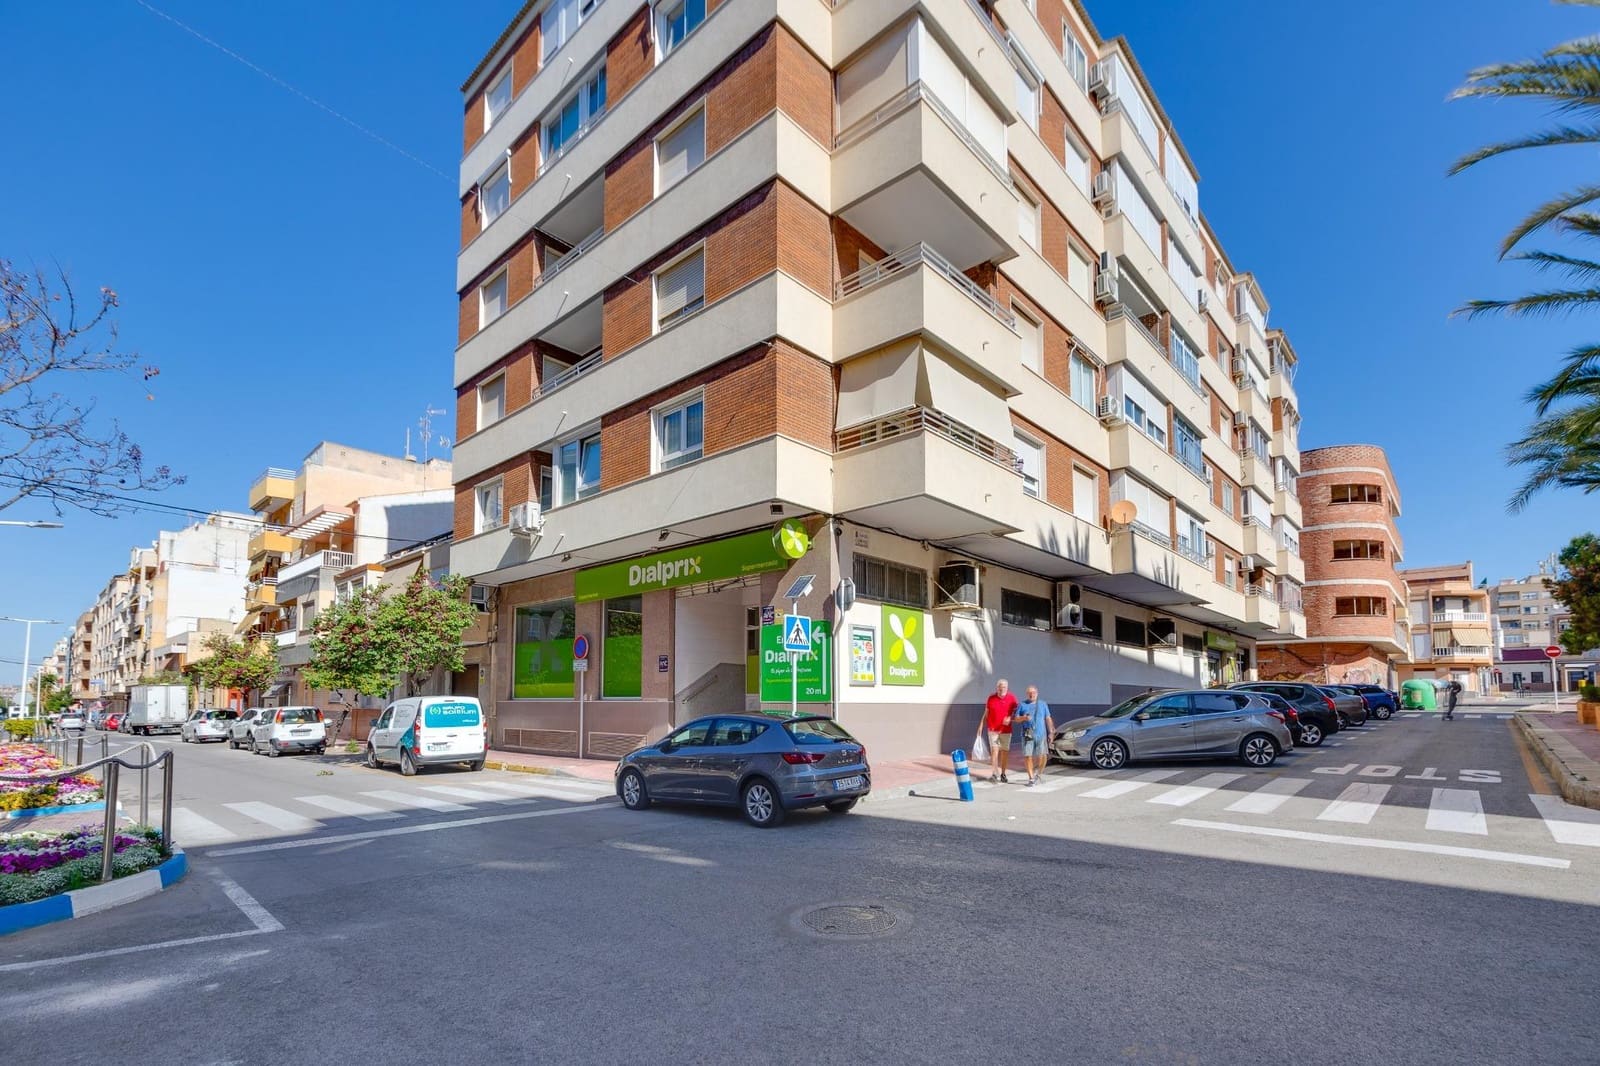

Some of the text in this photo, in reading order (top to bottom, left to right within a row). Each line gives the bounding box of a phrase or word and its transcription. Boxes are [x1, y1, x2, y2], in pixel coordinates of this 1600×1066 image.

[628, 556, 702, 587] Dialprix
[805, 687, 815, 695] 20
[1311, 763, 1503, 784] STOP
